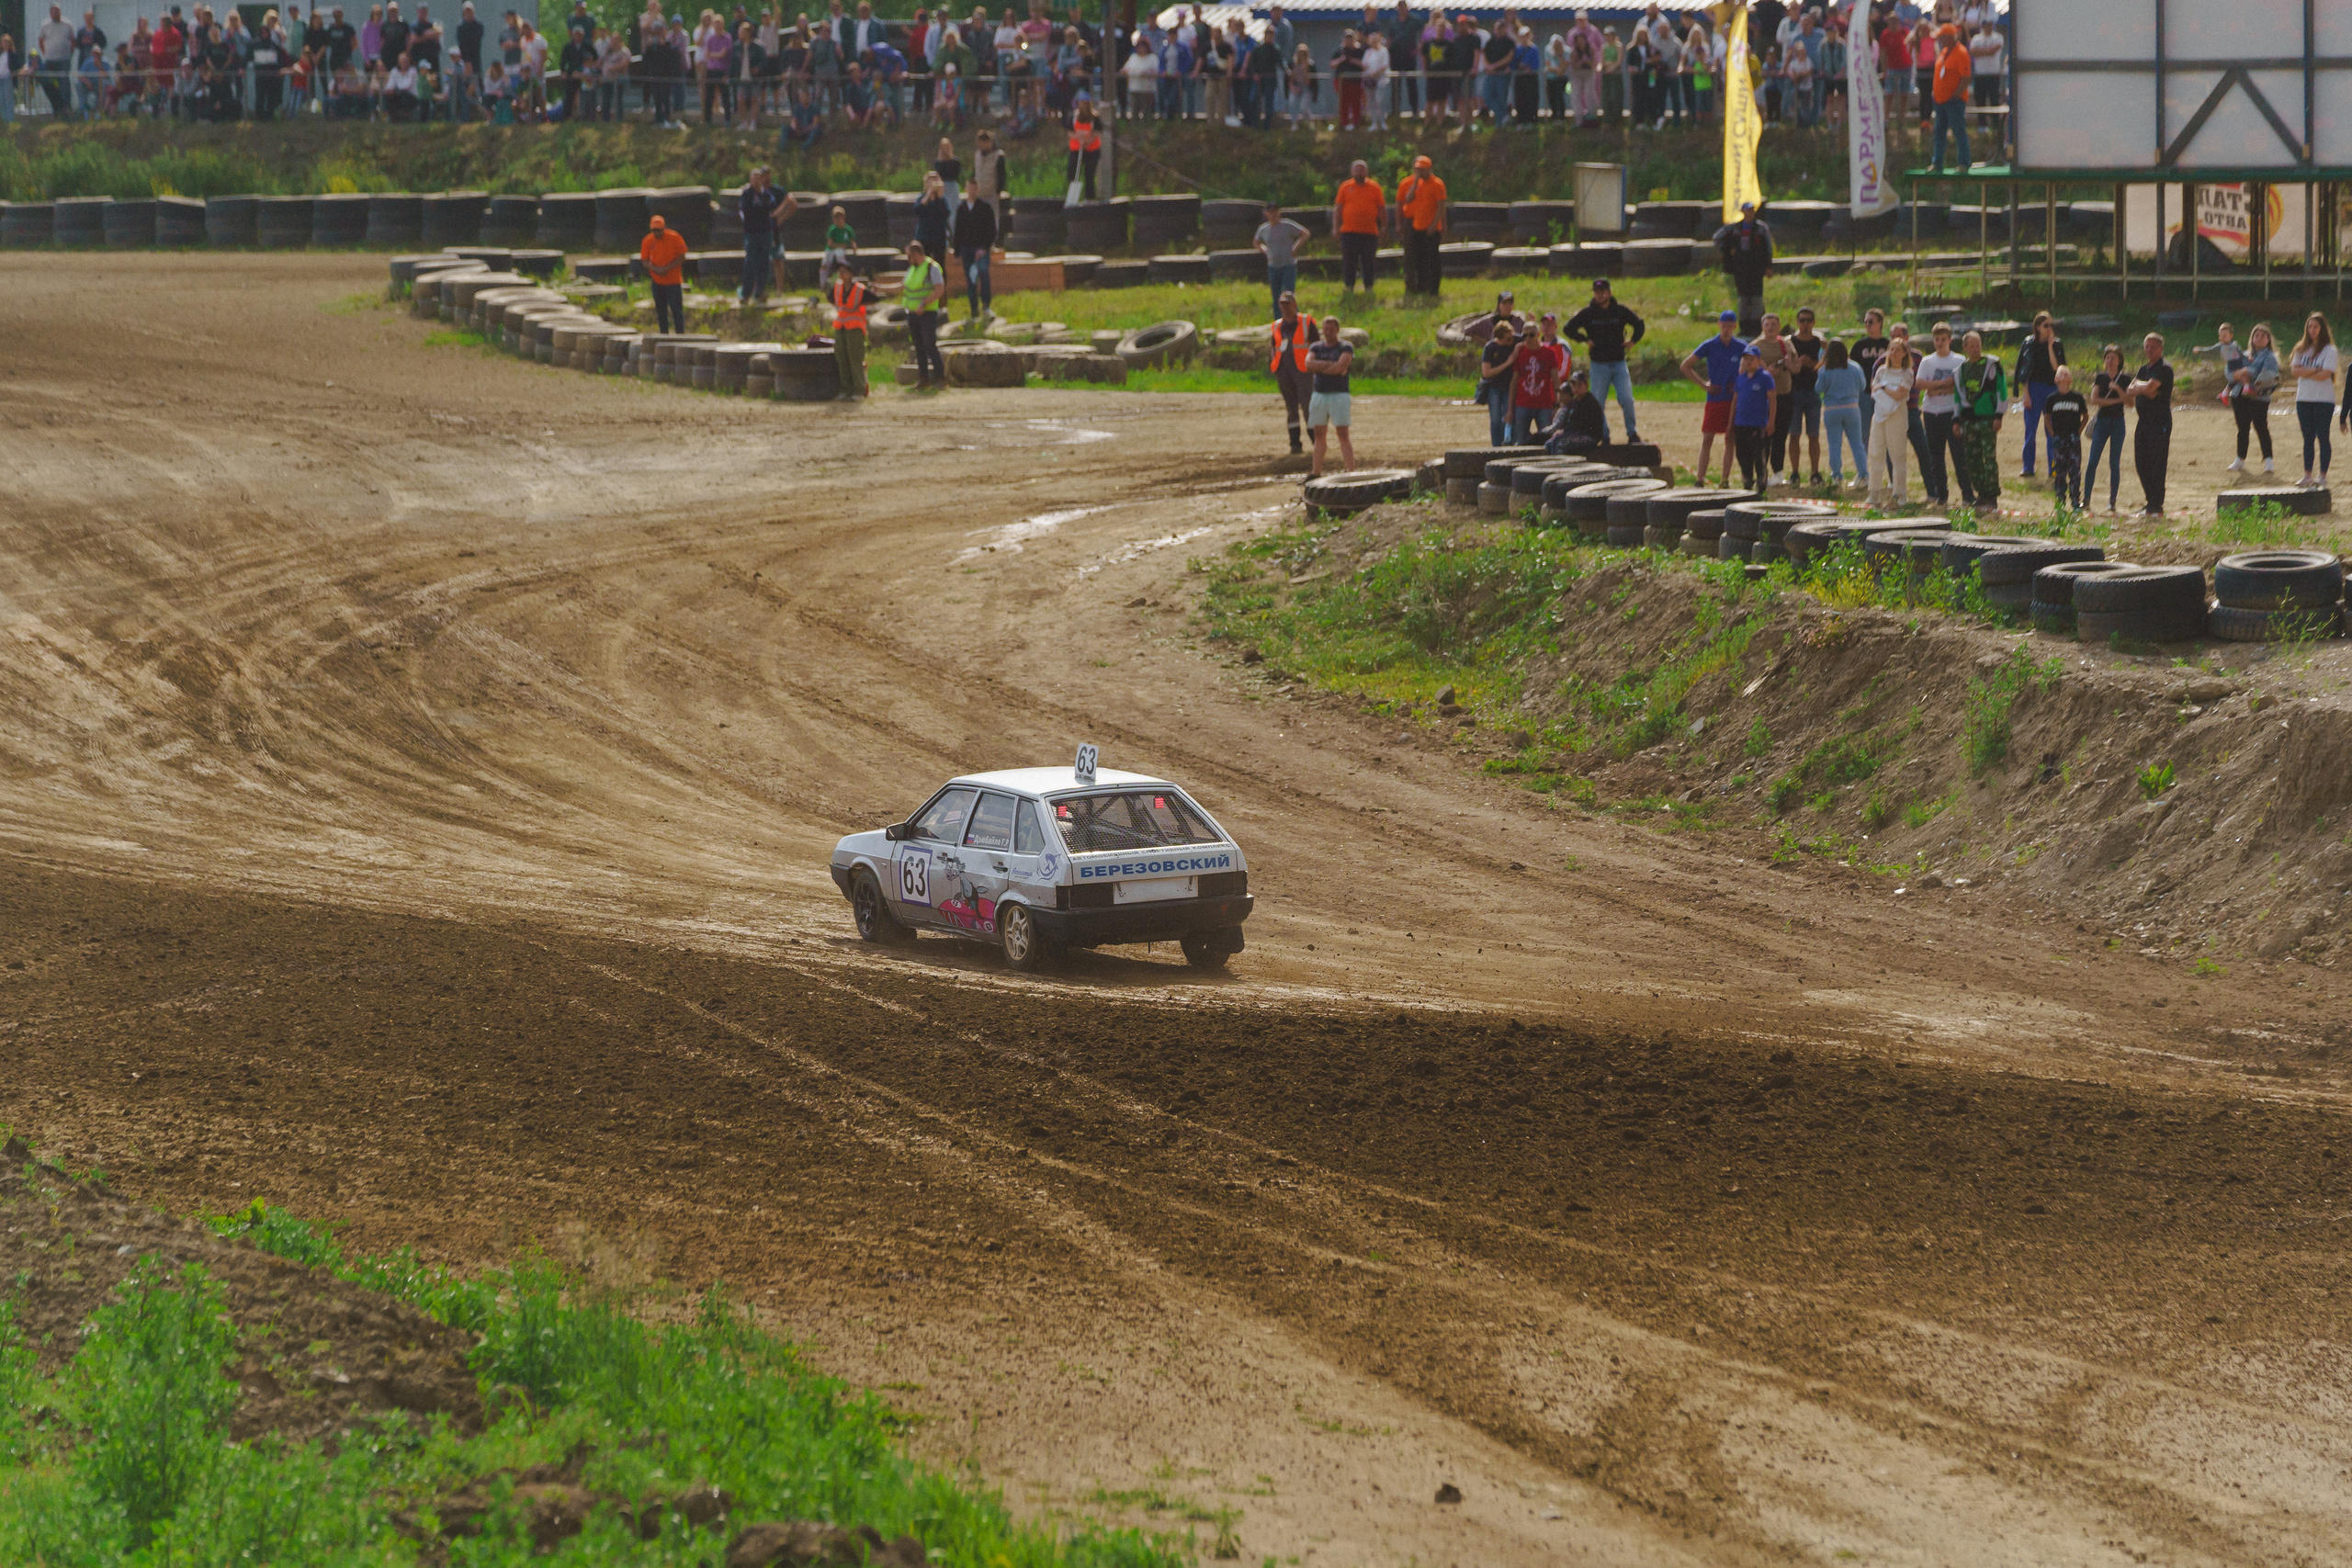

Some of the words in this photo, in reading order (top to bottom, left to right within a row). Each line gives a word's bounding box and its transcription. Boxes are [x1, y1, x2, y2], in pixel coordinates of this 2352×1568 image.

[1077, 746, 1096, 774] 63
[1072, 851, 1140, 861] АВТОМОБИЛЬНЫЙ
[1141, 846, 1191, 854] СПОРТИВНЫЙ
[1080, 853, 1230, 878] БЕРЕЗОВСКИЙ
[903, 855, 926, 897] 63
